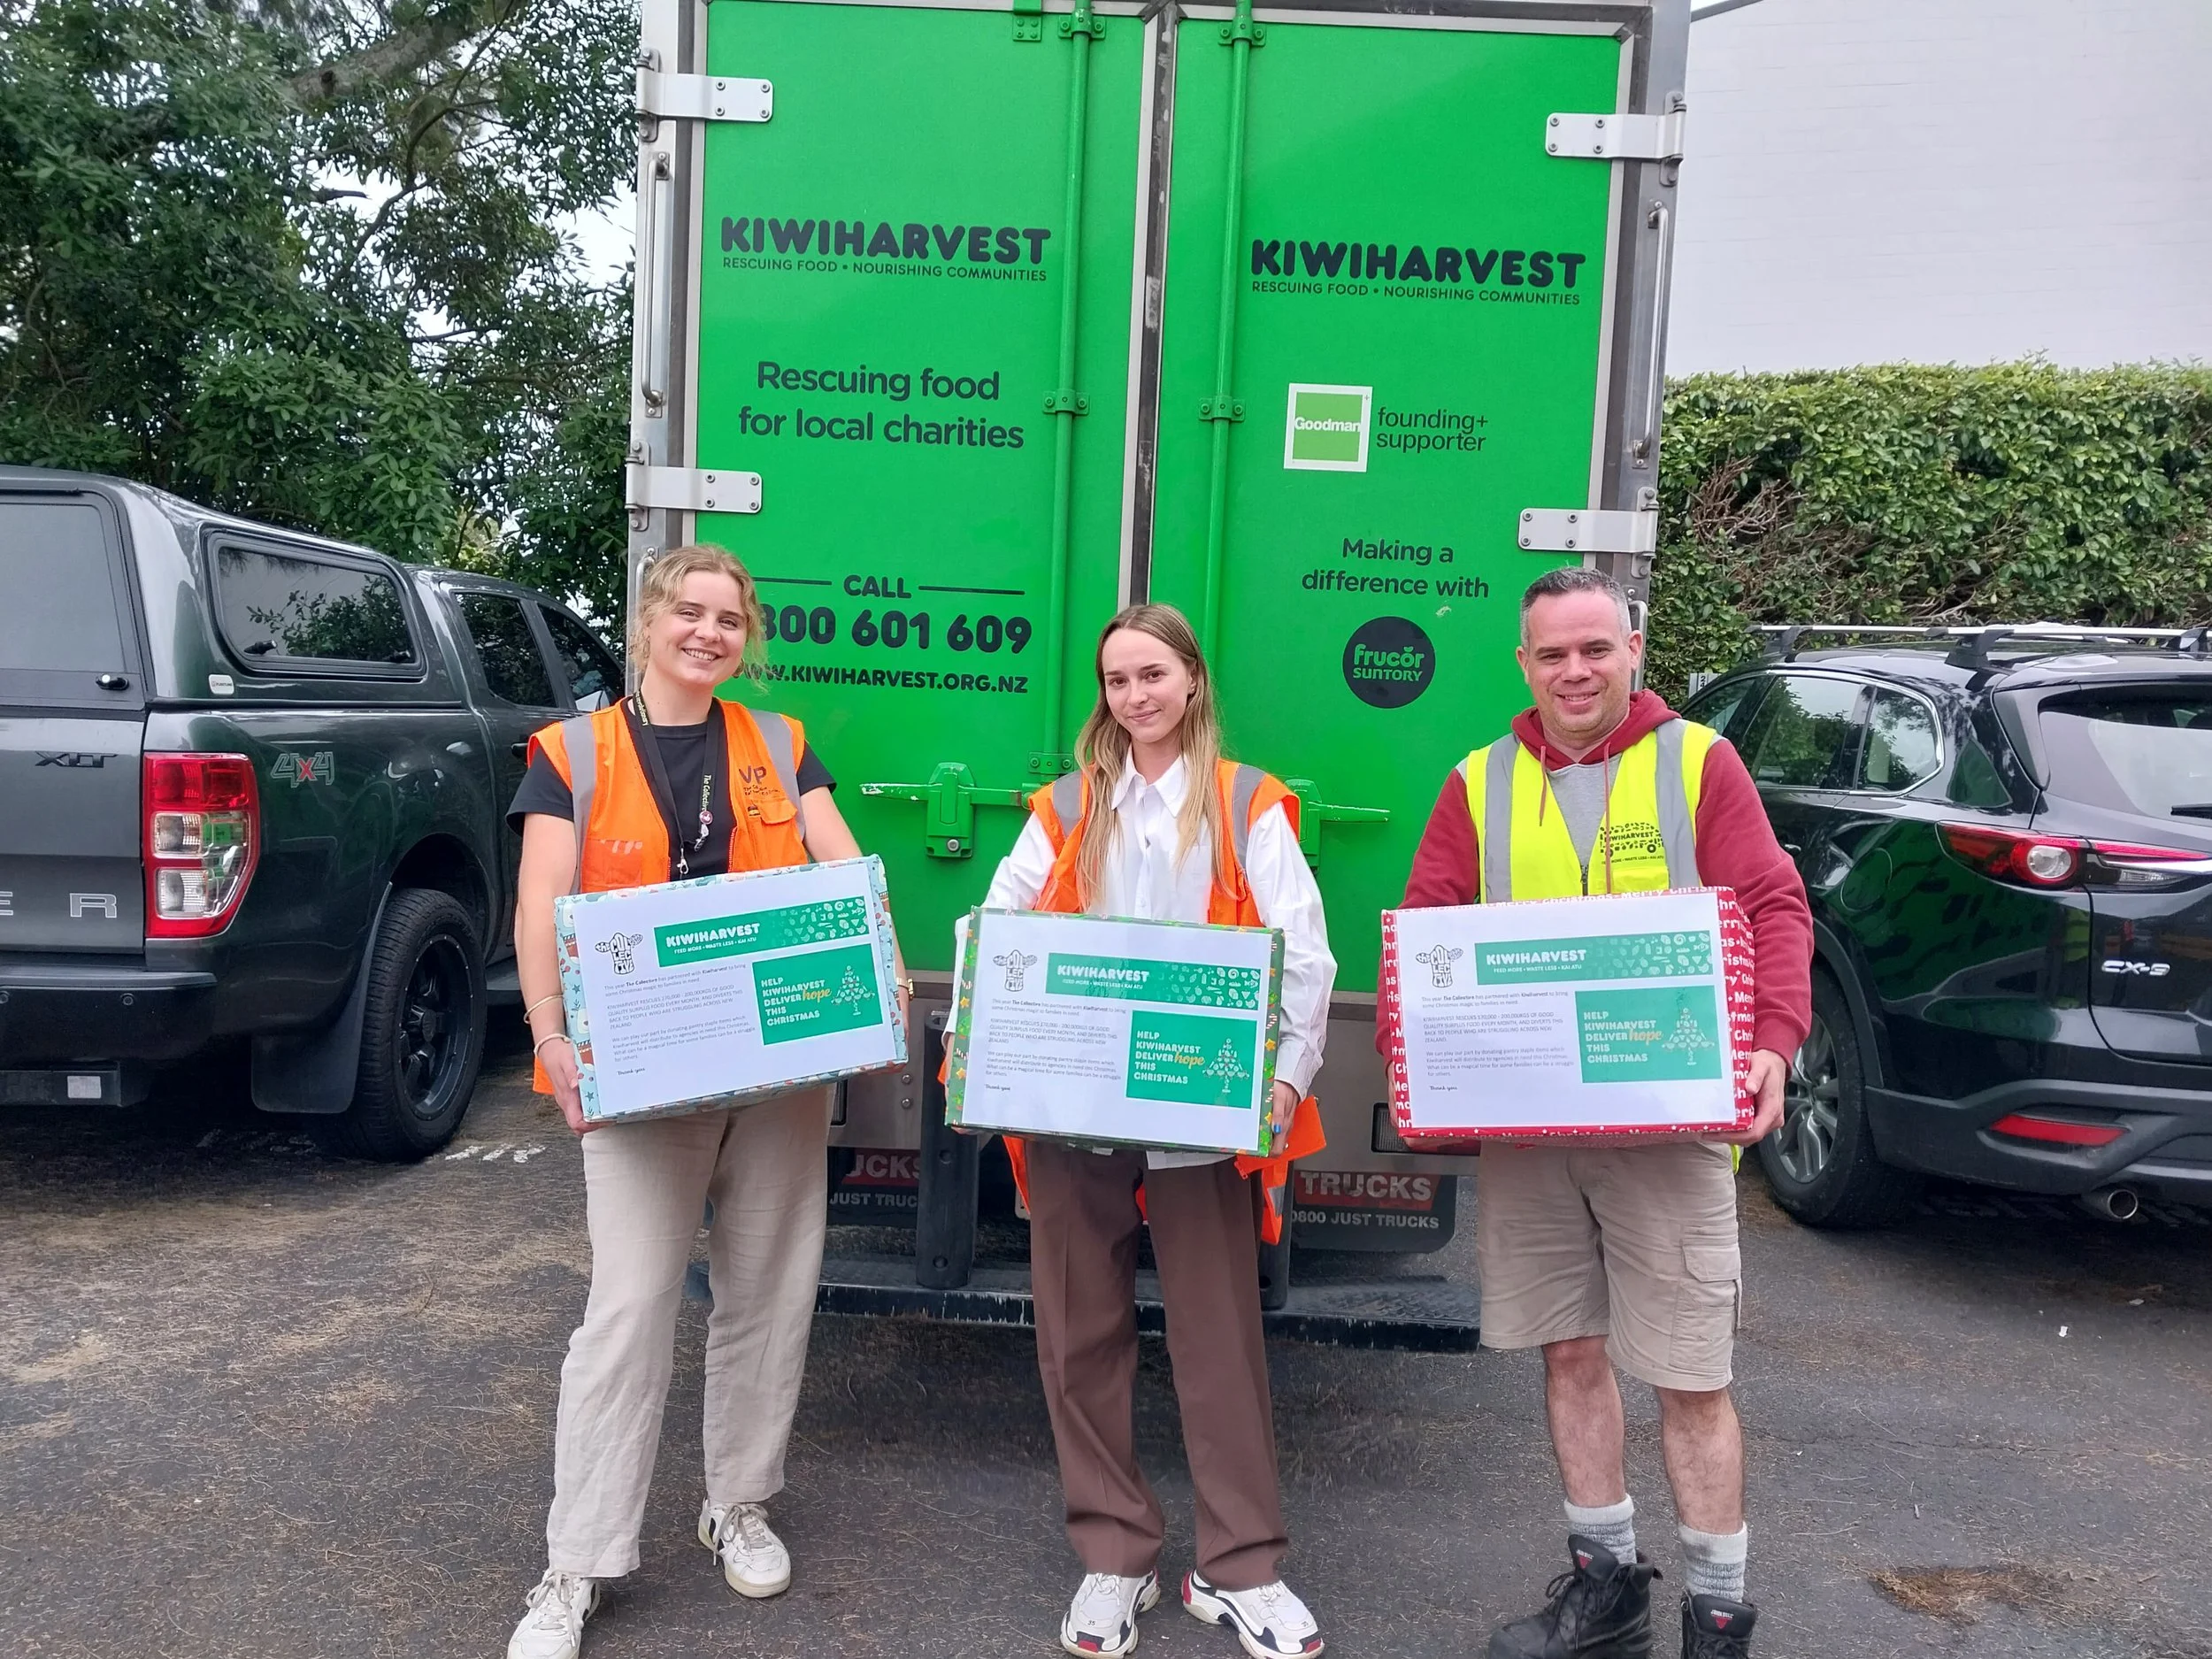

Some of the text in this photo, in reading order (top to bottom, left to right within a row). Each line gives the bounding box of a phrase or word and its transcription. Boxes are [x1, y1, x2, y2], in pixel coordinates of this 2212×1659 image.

[721, 217, 1051, 265] KIWIHARVEST
[723, 257, 1047, 281] RESCUING FOOD NOURISHING COMMUNITIES
[1251, 240, 1586, 288] KIWIHARVEST
[1252, 280, 1580, 305] RESCUING FOOD NOURISHING COMMUNITIES
[757, 361, 1000, 401] Rescuing food
[739, 407, 1025, 449] for local charities
[1294, 417, 1361, 433] Goodman
[1376, 431, 1486, 452] supporter
[1342, 538, 1454, 566] Making a
[843, 574, 911, 599] CALL
[1302, 570, 1489, 598] difference with
[760, 603, 1032, 654] 800 601 609
[743, 664, 1028, 694] WW.KIWIHARVEST.ORG.NZ
[35, 751, 118, 768] XLT
[739, 765, 767, 784] VP
[666, 924, 760, 948] KIWIHARVEST
[1486, 949, 1586, 965] KIWIHARVEST
[1057, 964, 1149, 982] KIWIHARVEST
[2101, 959, 2171, 976] CX-9
[761, 977, 783, 987] HELP
[763, 979, 825, 997] KIWIHARVEST
[764, 988, 832, 1007] DELIVER hope
[765, 1007, 787, 1016] THIS
[767, 1010, 820, 1025] CHRISTMAS
[1584, 1011, 1609, 1020] HELP
[1584, 1020, 1656, 1031] KIWIHARVEST
[1137, 1031, 1160, 1040] HELP
[1586, 1029, 1663, 1046] DELIVER hope
[1136, 1041, 1201, 1054] KIWIHARVEST
[1135, 1051, 1205, 1069] DELIVER hope
[1135, 1062, 1156, 1071] THIS
[1587, 1053, 1647, 1064] CHRISTMAS
[1133, 1071, 1188, 1084] CHRISTMAS
[1300, 1171, 1432, 1202] TRUCKS
[829, 1193, 918, 1208] JUST TRUC
[1331, 1212, 1371, 1226] JUST
[1376, 1214, 1440, 1229] TRUCKS
